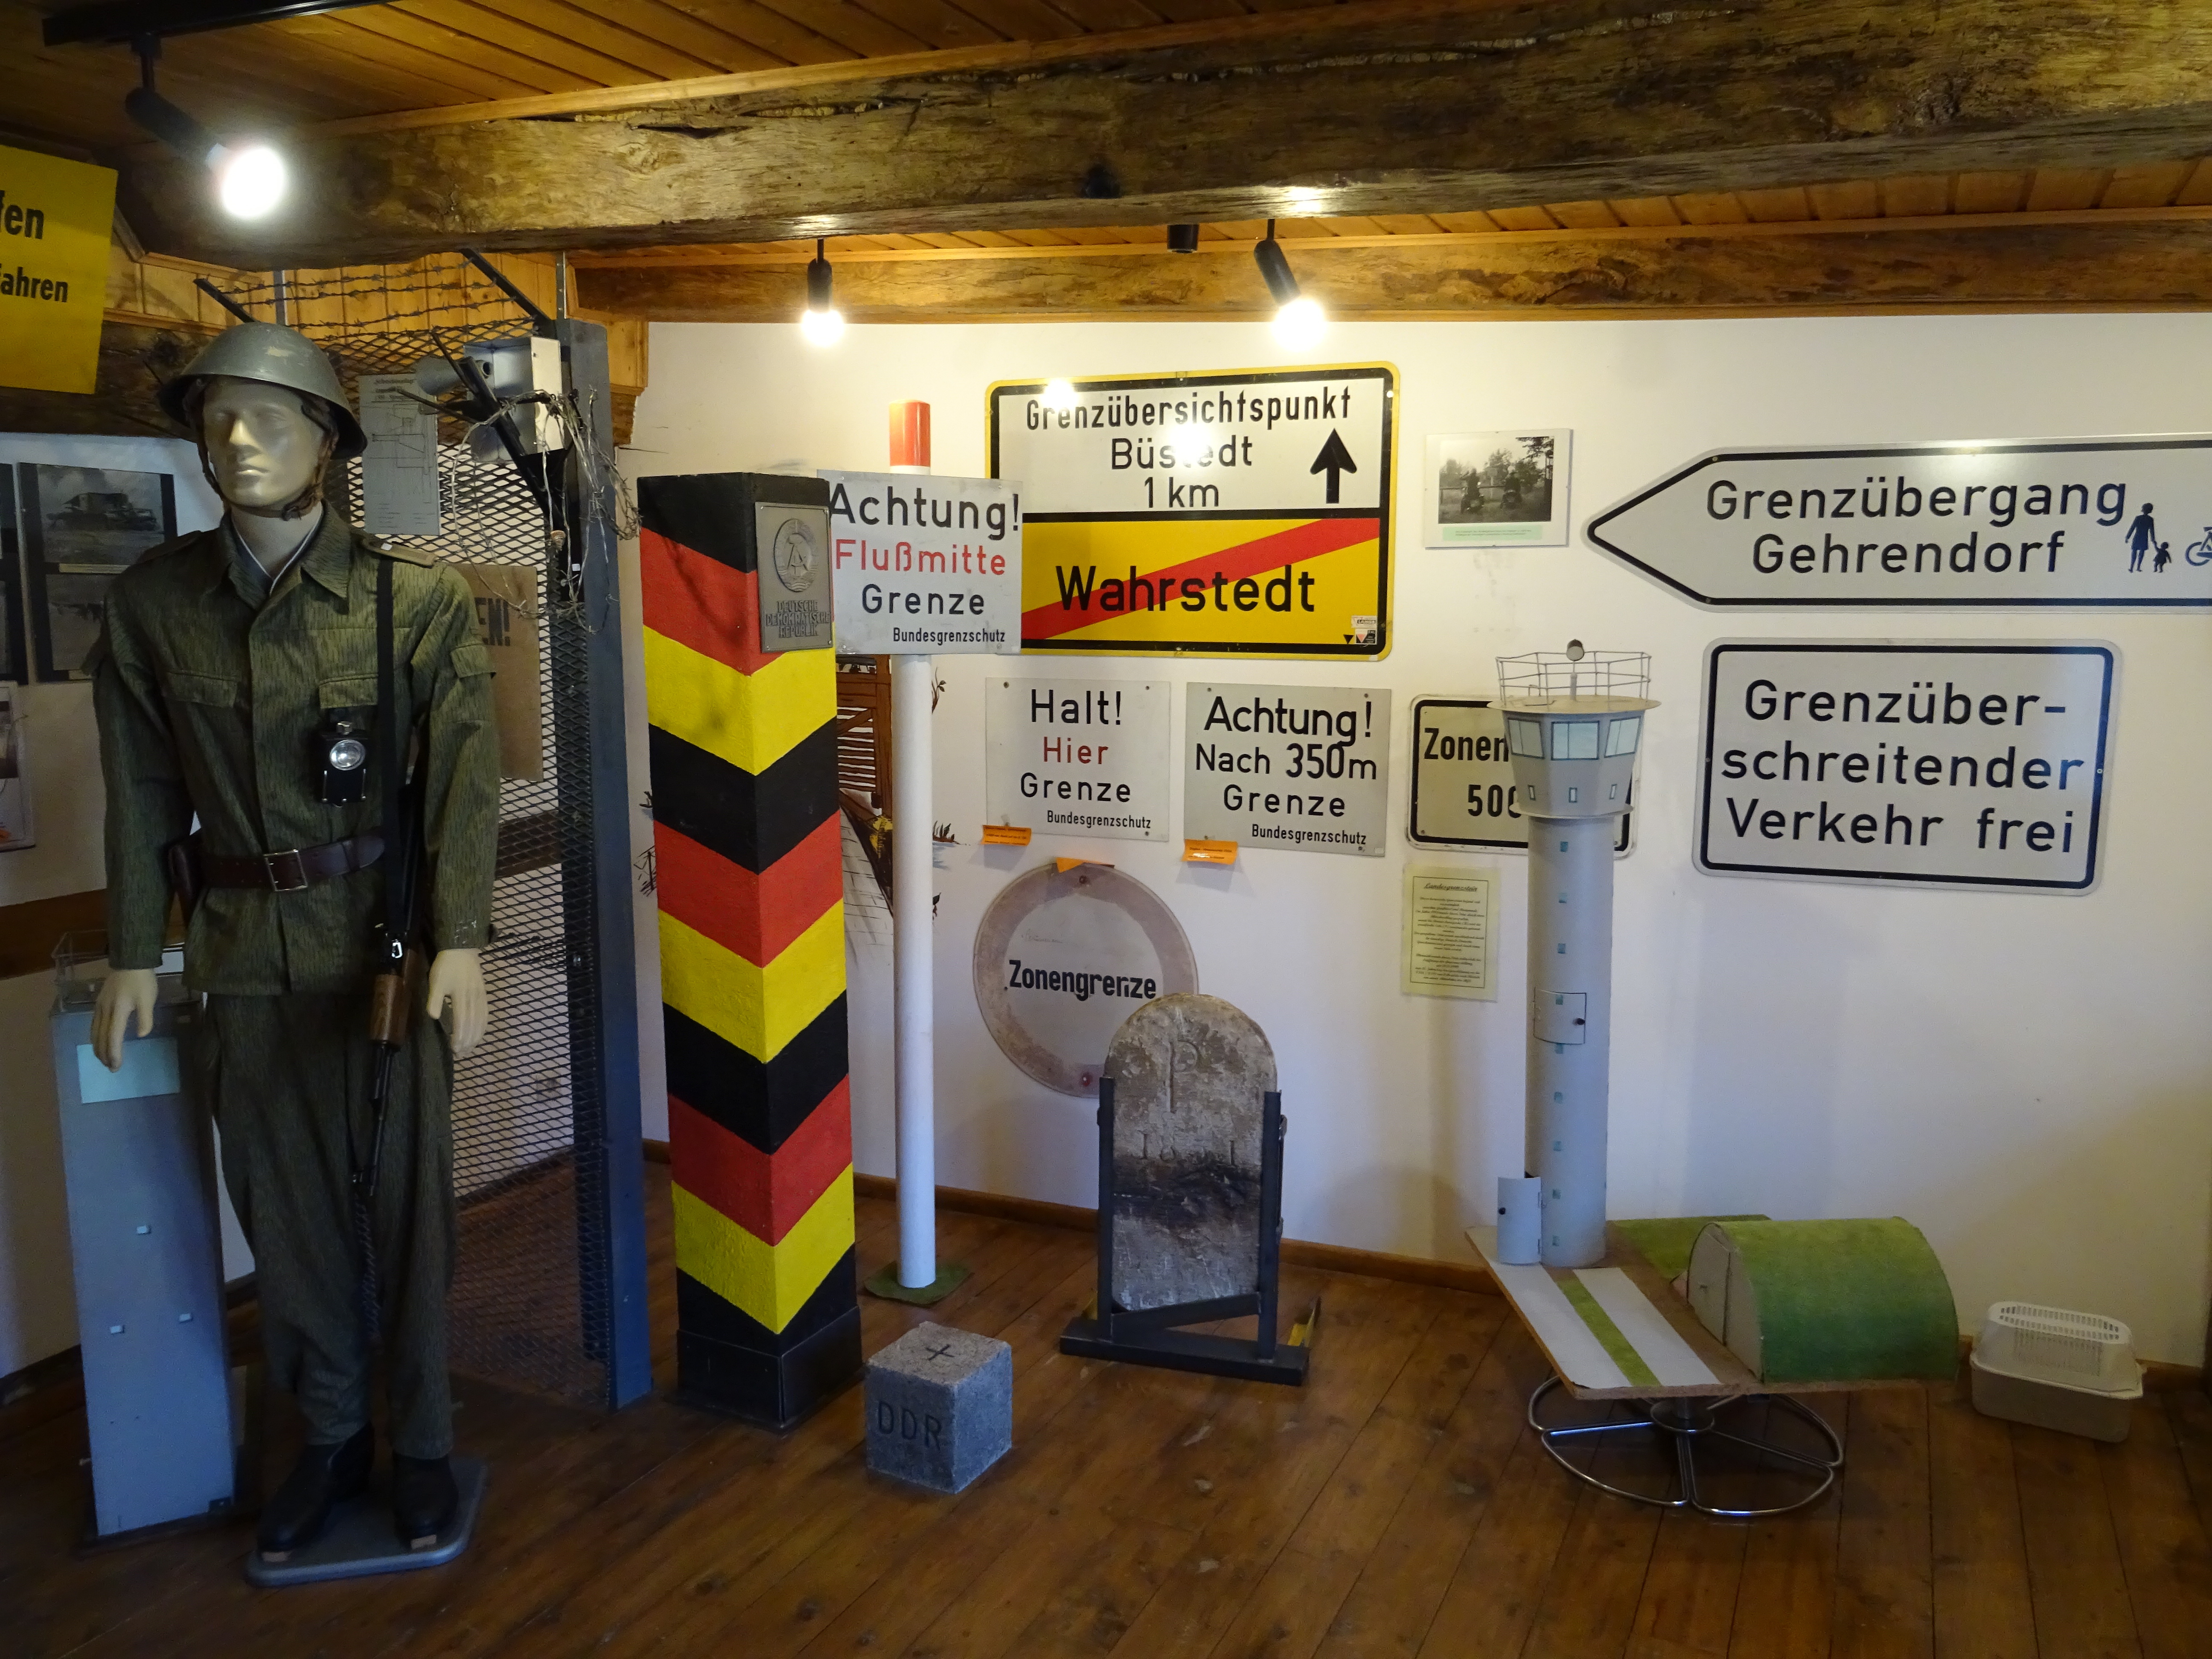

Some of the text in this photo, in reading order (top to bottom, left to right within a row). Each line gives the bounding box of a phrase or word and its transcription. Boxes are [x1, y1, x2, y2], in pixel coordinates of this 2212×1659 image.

[0, 190, 44, 240] en
[0, 263, 68, 303] ahren
[1027, 386, 1351, 431] Grenzübersichtspunkt
[1112, 434, 1253, 470] Büsedt
[1144, 476, 1219, 508] 1 km
[1707, 476, 2126, 527] Grenzübergang
[830, 483, 1019, 541] Achtung!
[836, 539, 1006, 575] Flußmitte
[1753, 530, 2065, 573] Gehrendorf
[777, 599, 818, 613] DEUTSCHE
[862, 584, 984, 615] Grenze
[1056, 565, 1316, 612] Wahrstedt
[765, 611, 830, 626] DEMOKRATISCHE
[779, 624, 818, 638] REPUBLIK
[893, 627, 1005, 646] Bundesgrenzschutz
[1031, 689, 1121, 726] Halt!
[1745, 679, 2066, 725] Grenzüber-
[1204, 696, 1372, 747] Achtung!
[1043, 736, 1108, 765] Hier
[1196, 743, 1377, 780] Nach 350m
[1721, 740, 2084, 790] schreitender
[1021, 772, 1131, 803] Grenze
[1224, 784, 1345, 817] Grenze
[1047, 810, 1151, 829] Bundesgrenzschutz
[1252, 824, 1367, 845] Bundesgrenzschutz
[1726, 797, 2073, 853] Verkehr frei
[1009, 960, 1156, 1001] Zonengrenze
[878, 1400, 941, 1450] DDR
